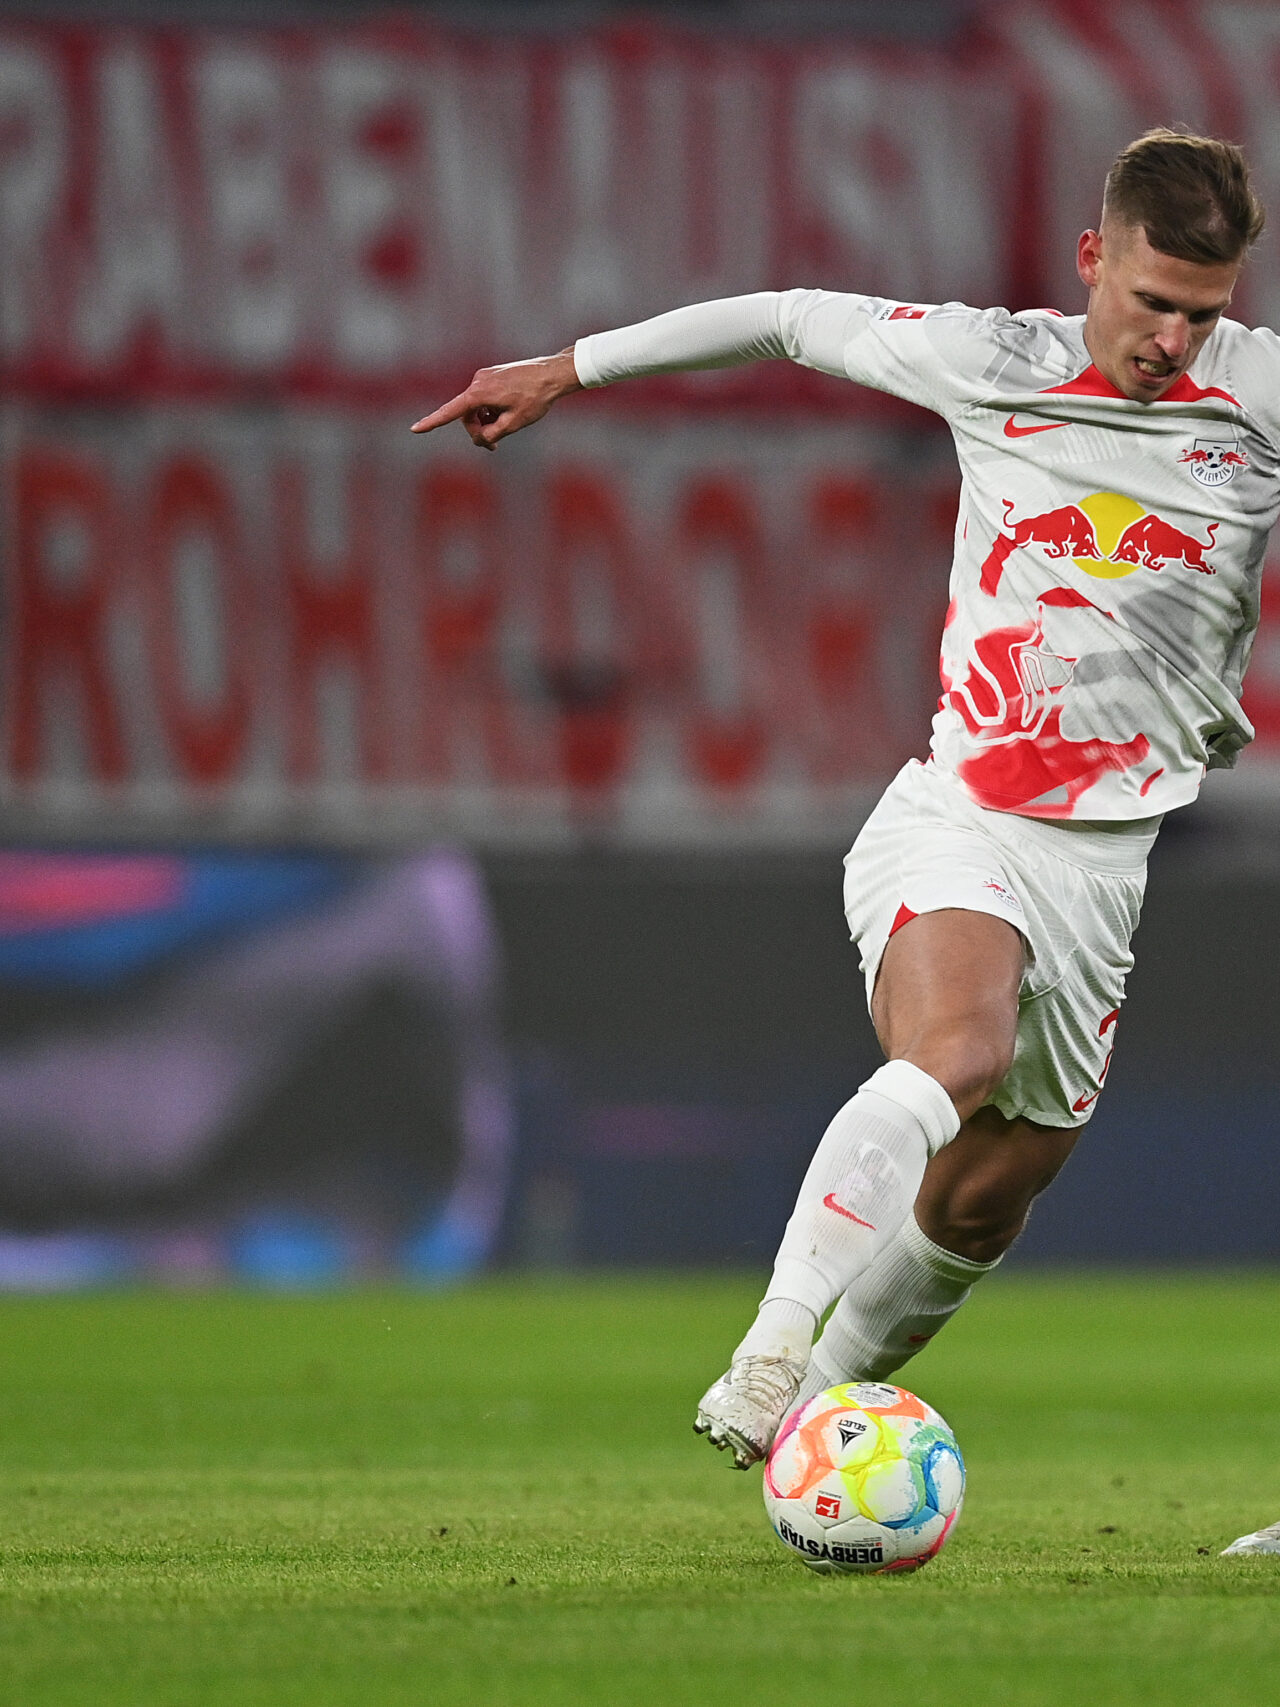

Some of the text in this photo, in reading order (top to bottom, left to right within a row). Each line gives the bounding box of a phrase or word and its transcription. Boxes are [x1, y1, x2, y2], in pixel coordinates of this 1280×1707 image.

[1203, 466, 1231, 482] LEIPZIG
[838, 1418, 868, 1432] SELECT
[779, 1520, 884, 1564] DERBYSTAR
